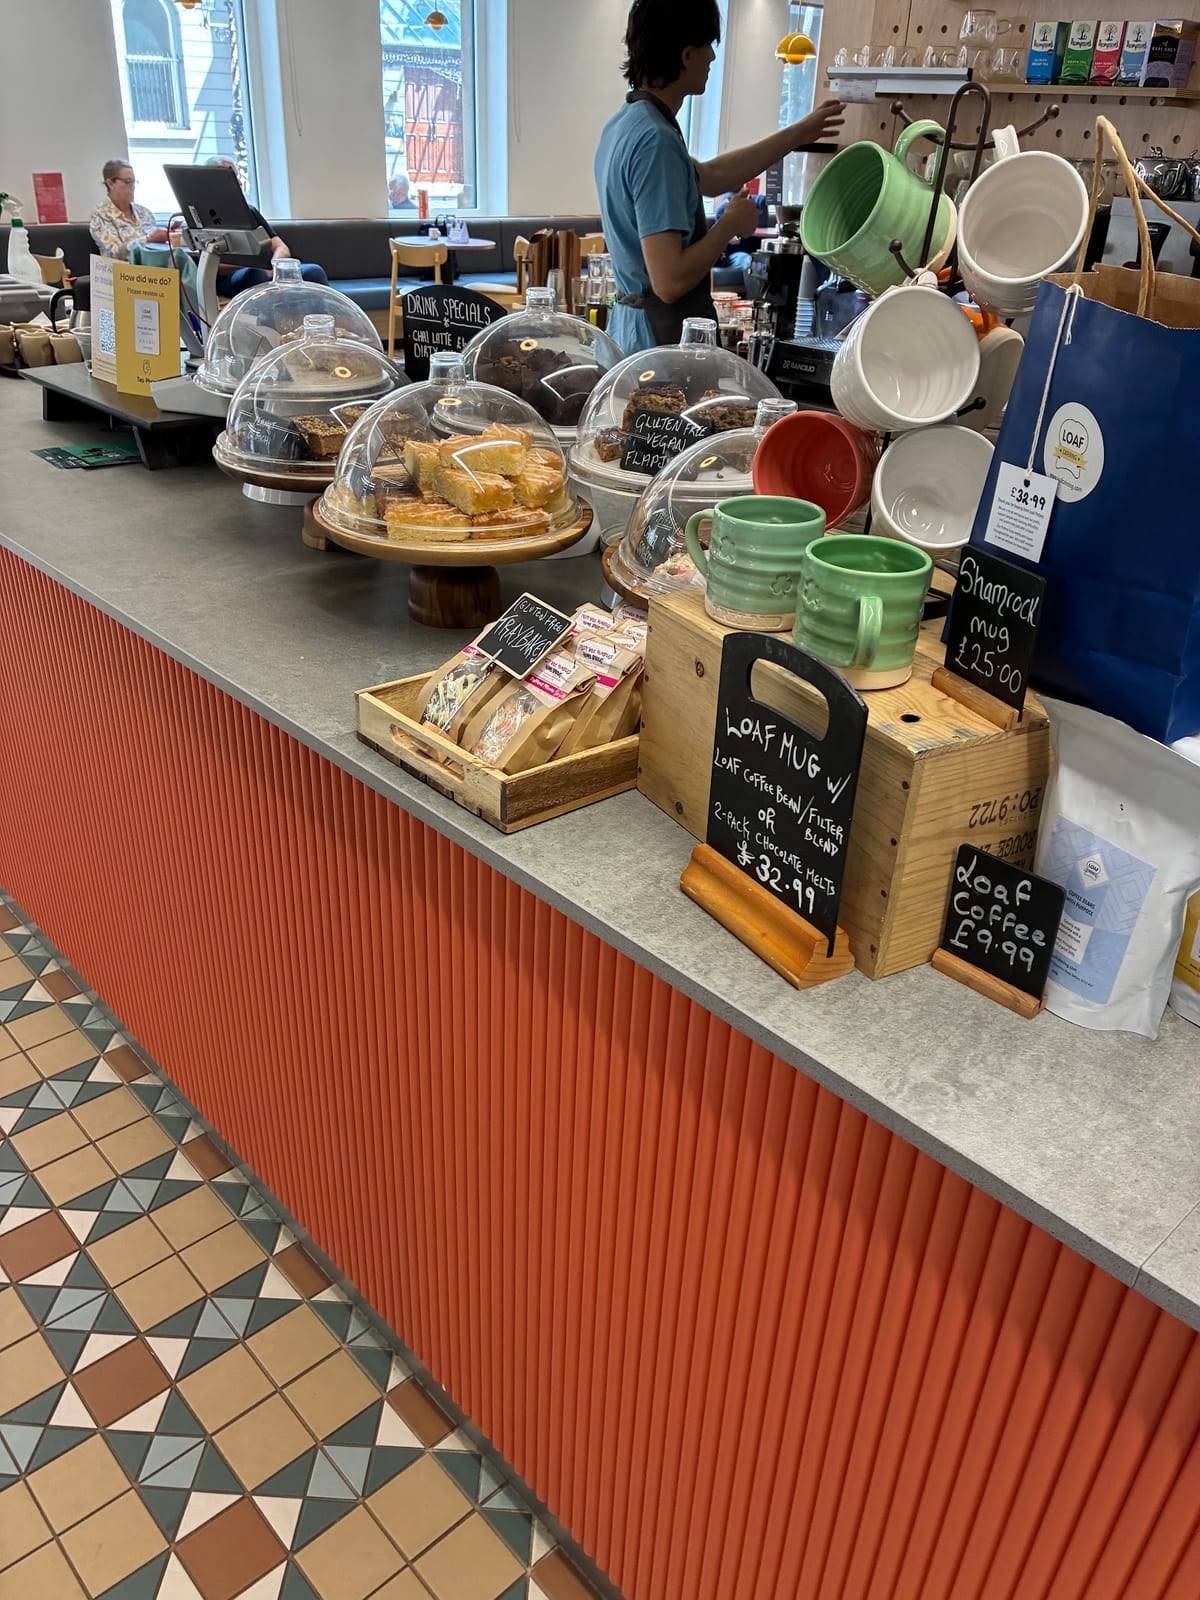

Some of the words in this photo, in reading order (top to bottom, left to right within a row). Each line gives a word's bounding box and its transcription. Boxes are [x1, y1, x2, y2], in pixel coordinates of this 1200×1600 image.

[120, 272, 136, 283] How
[136, 274, 147, 284] did
[148, 277, 159, 285] we
[159, 277, 172, 286] do?
[126, 287, 142, 297] Please
[407, 294, 439, 317] DRINK
[442, 298, 491, 326] SPECIALS
[412, 329, 430, 344] CHAI
[431, 332, 453, 347] LATTE
[635, 413, 684, 433] GLUTEN
[682, 422, 709, 437] FREE
[1062, 428, 1085, 449] LOAF
[646, 431, 687, 454] VEGAN
[625, 450, 671, 469] FLAPJ
[1010, 486, 1046, 511] £32.99
[960, 556, 1040, 627] Shamrock
[494, 614, 552, 663] TRAYBAKES
[970, 616, 1010, 653] mug
[955, 636, 1022, 693] £25.00
[726, 707, 777, 752] LOAF
[779, 731, 821, 778] MUG
[714, 747, 742, 775] LOAF
[758, 807, 776, 835] OR
[714, 801, 750, 840] 2-PACK
[756, 832, 803, 874] CHOCOLATE
[806, 868, 836, 896] MELTS
[804, 828, 839, 857] BLEND
[956, 854, 1032, 907] Loaf
[953, 891, 1046, 947] Coffee
[950, 918, 1035, 973] £9.99
